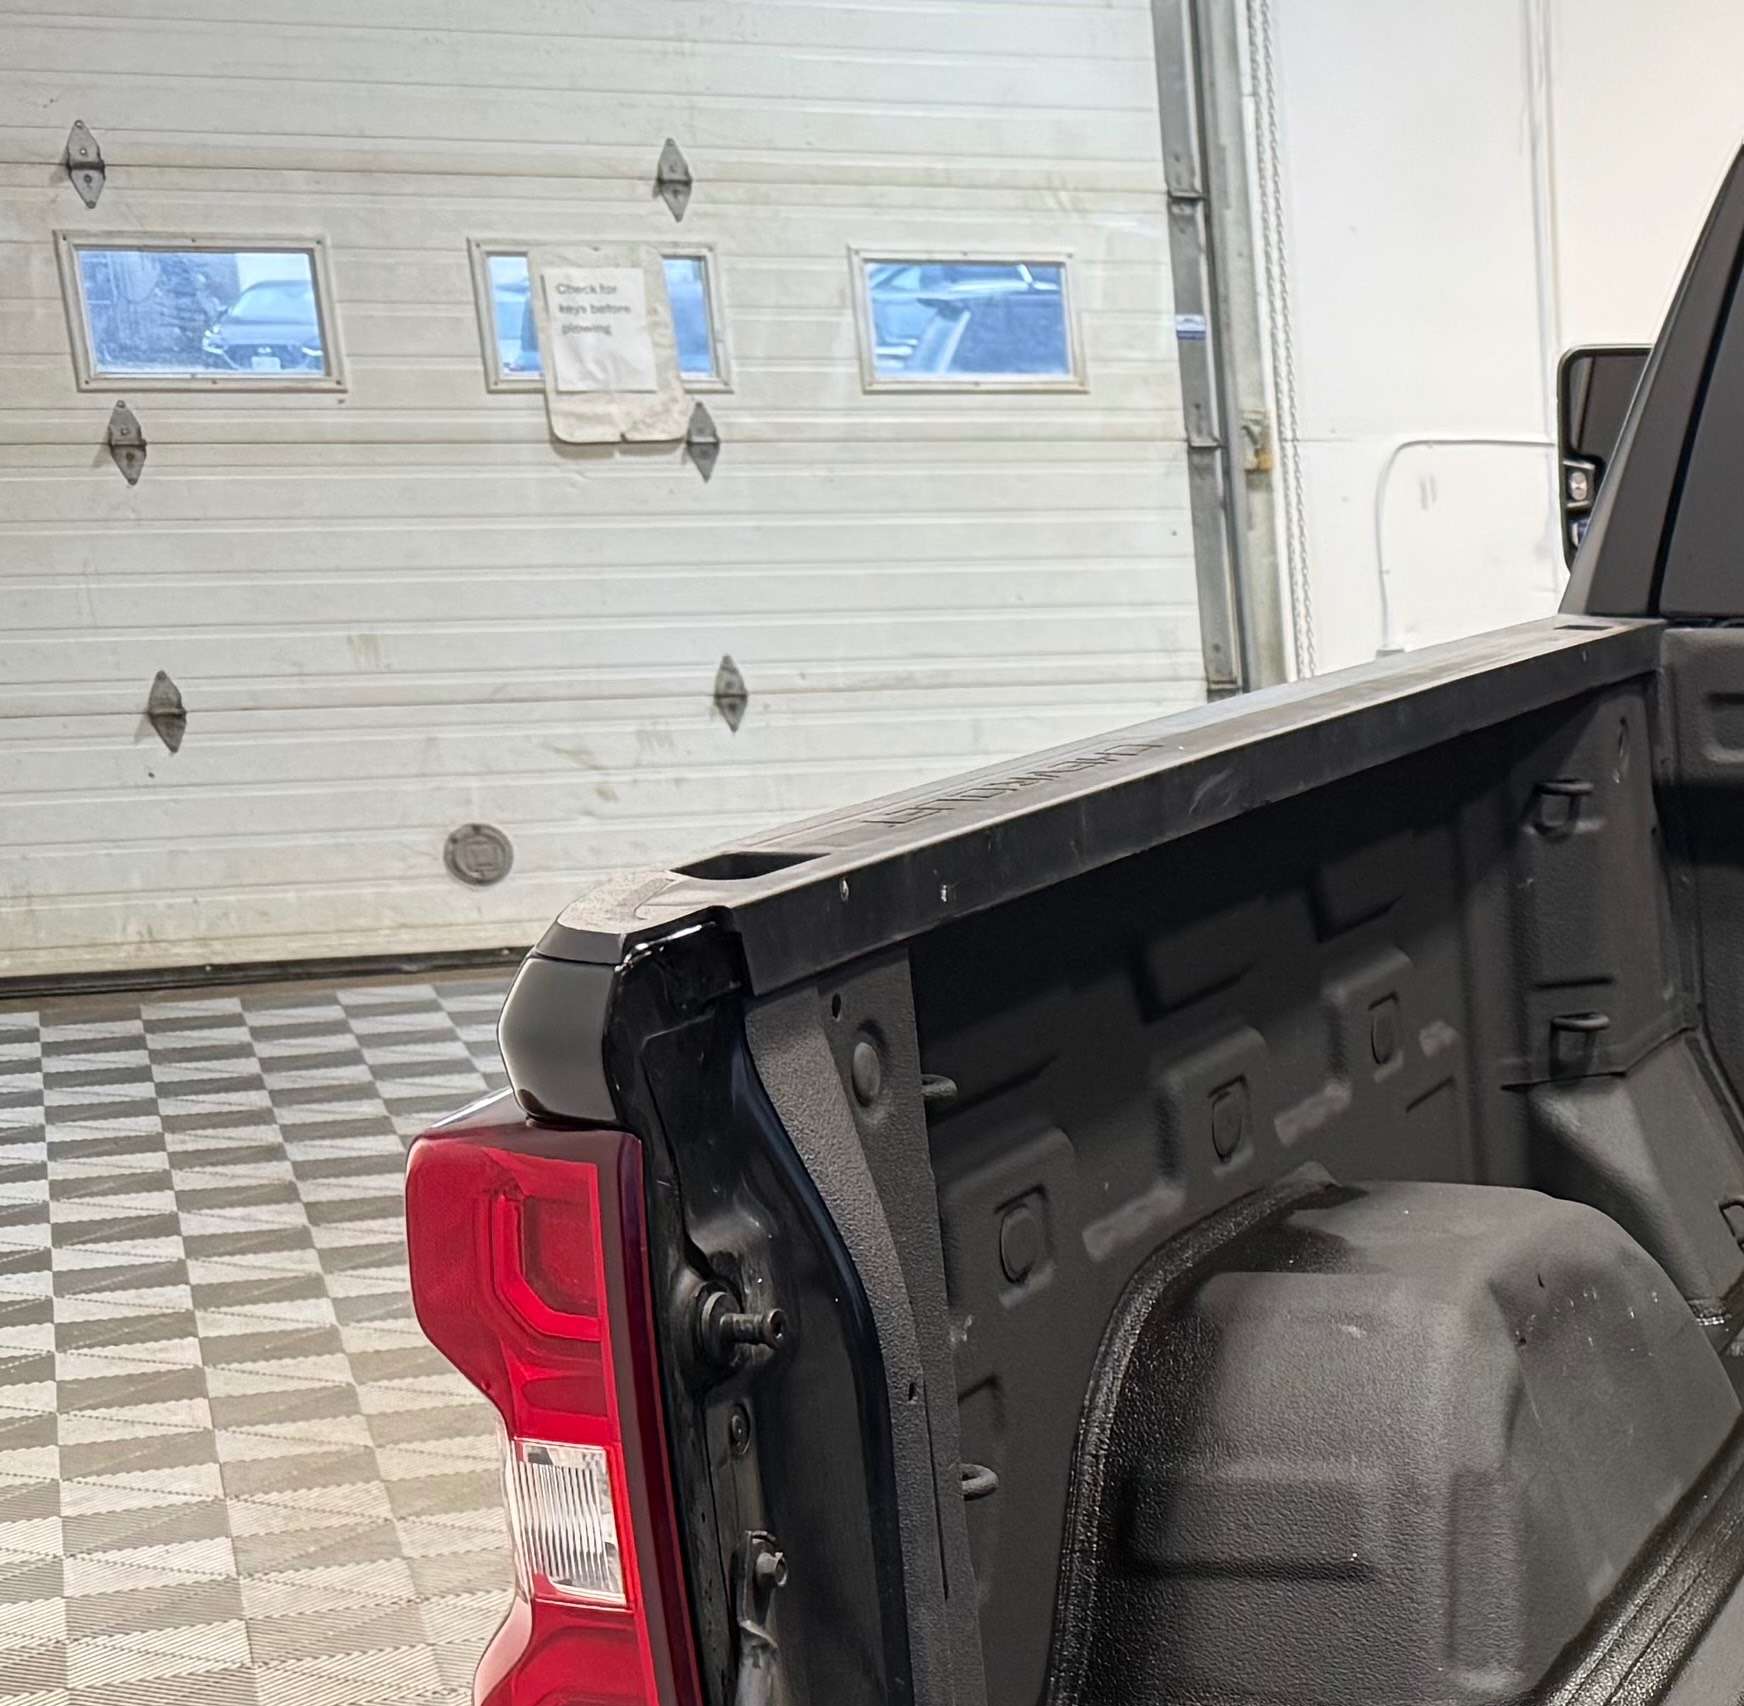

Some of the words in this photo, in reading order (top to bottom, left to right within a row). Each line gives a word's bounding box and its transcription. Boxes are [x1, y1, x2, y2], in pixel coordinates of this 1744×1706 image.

[555, 283, 597, 295] Check
[599, 283, 617, 295] for
[559, 303, 588, 317] keys
[589, 303, 632, 315] before
[861, 743, 1165, 828] CHEVROLET
